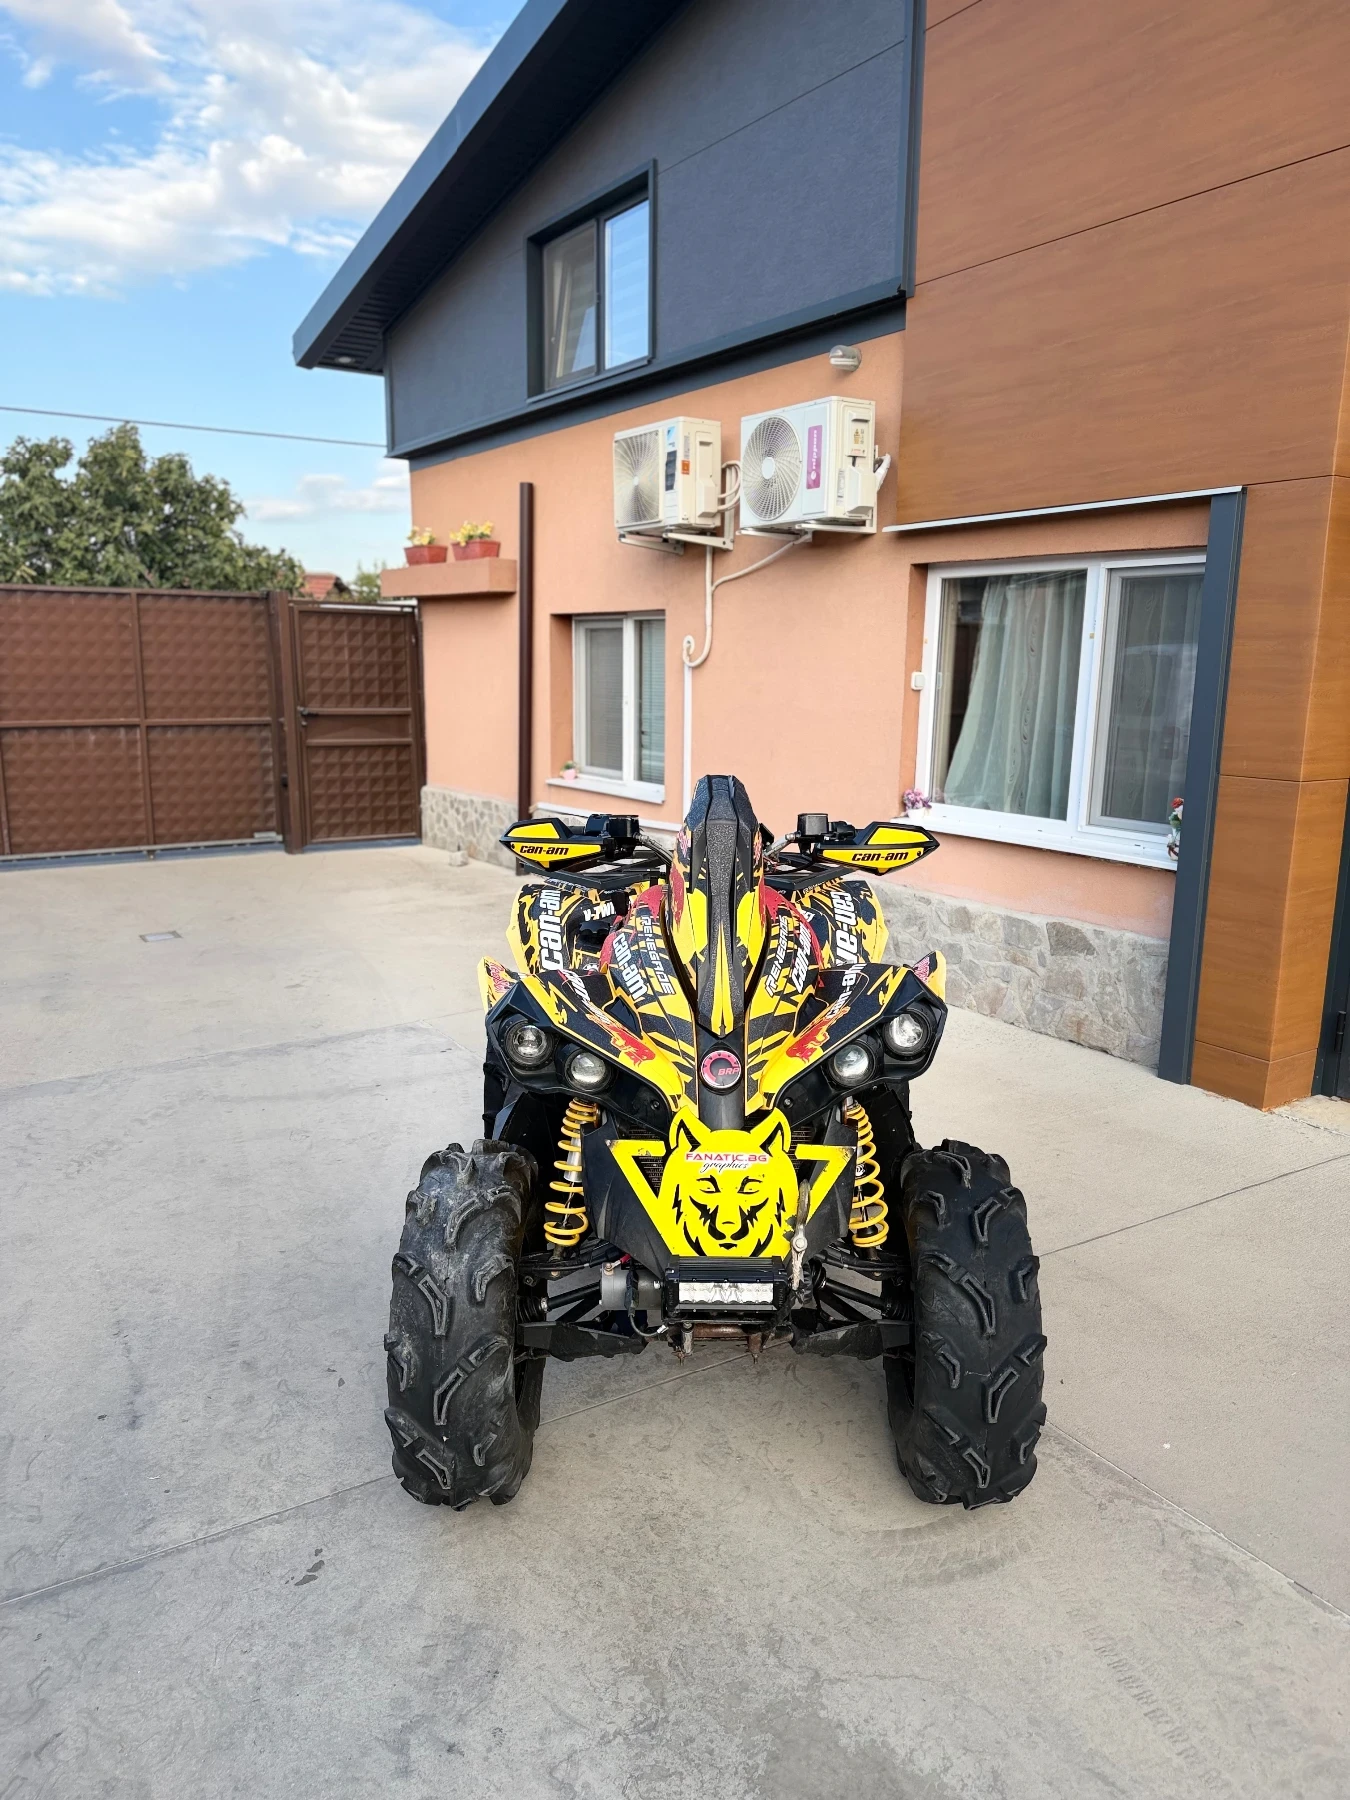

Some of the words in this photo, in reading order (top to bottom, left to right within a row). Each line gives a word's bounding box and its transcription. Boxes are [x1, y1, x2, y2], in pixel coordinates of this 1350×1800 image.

[519, 845, 569, 855] can-am
[851, 852, 909, 862] can-am
[583, 901, 617, 921] V-TWI
[539, 889, 564, 971] can-am
[641, 915, 676, 994] RENEGADE
[612, 932, 648, 1000] can-am
[717, 1067, 740, 1076] BRP
[686, 1153, 768, 1162] FANATIC.BG
[700, 1159, 749, 1173] graphics
